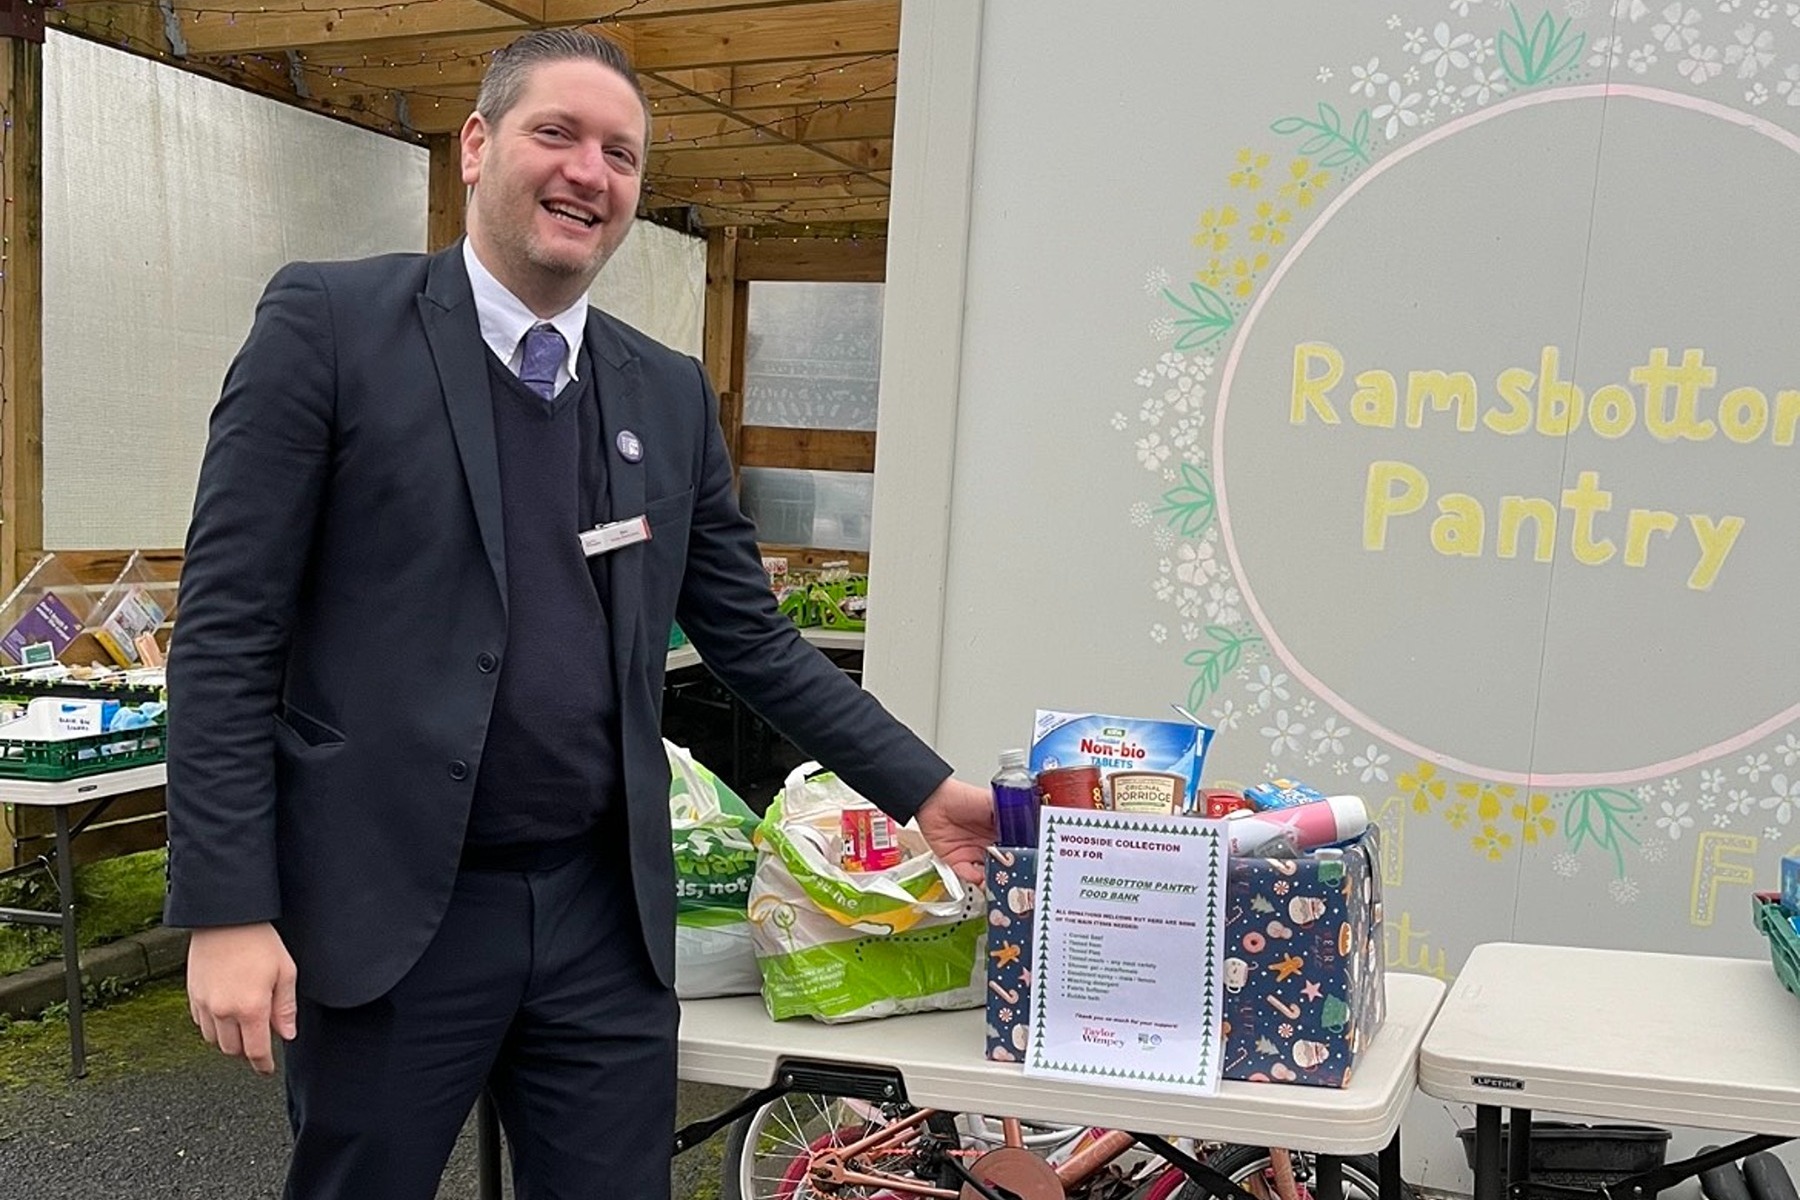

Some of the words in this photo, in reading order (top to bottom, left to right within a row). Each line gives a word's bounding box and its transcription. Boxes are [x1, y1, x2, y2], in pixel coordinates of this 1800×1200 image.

[1362, 461, 1745, 592] Pantry
[1081, 739, 1145, 759] Non-bio
[1091, 756, 1133, 769] TABLETS
[1125, 784, 1160, 792] ORIGINAL
[1117, 791, 1171, 803] PORRIDGE
[1060, 834, 1112, 846] WOODSIDE
[1115, 839, 1180, 853] COLLECTION
[1059, 848, 1080, 857] BOX
[1082, 850, 1102, 859] FOR
[709, 877, 748, 894] not
[1080, 875, 1152, 889] RAMSBOTTOM
[1155, 882, 1197, 893] PANTRY
[1079, 889, 1107, 899] FOOD
[1110, 891, 1139, 902] BANK
[1082, 1026, 1115, 1038] Taylor
[1082, 1034, 1124, 1048] Wimpey
